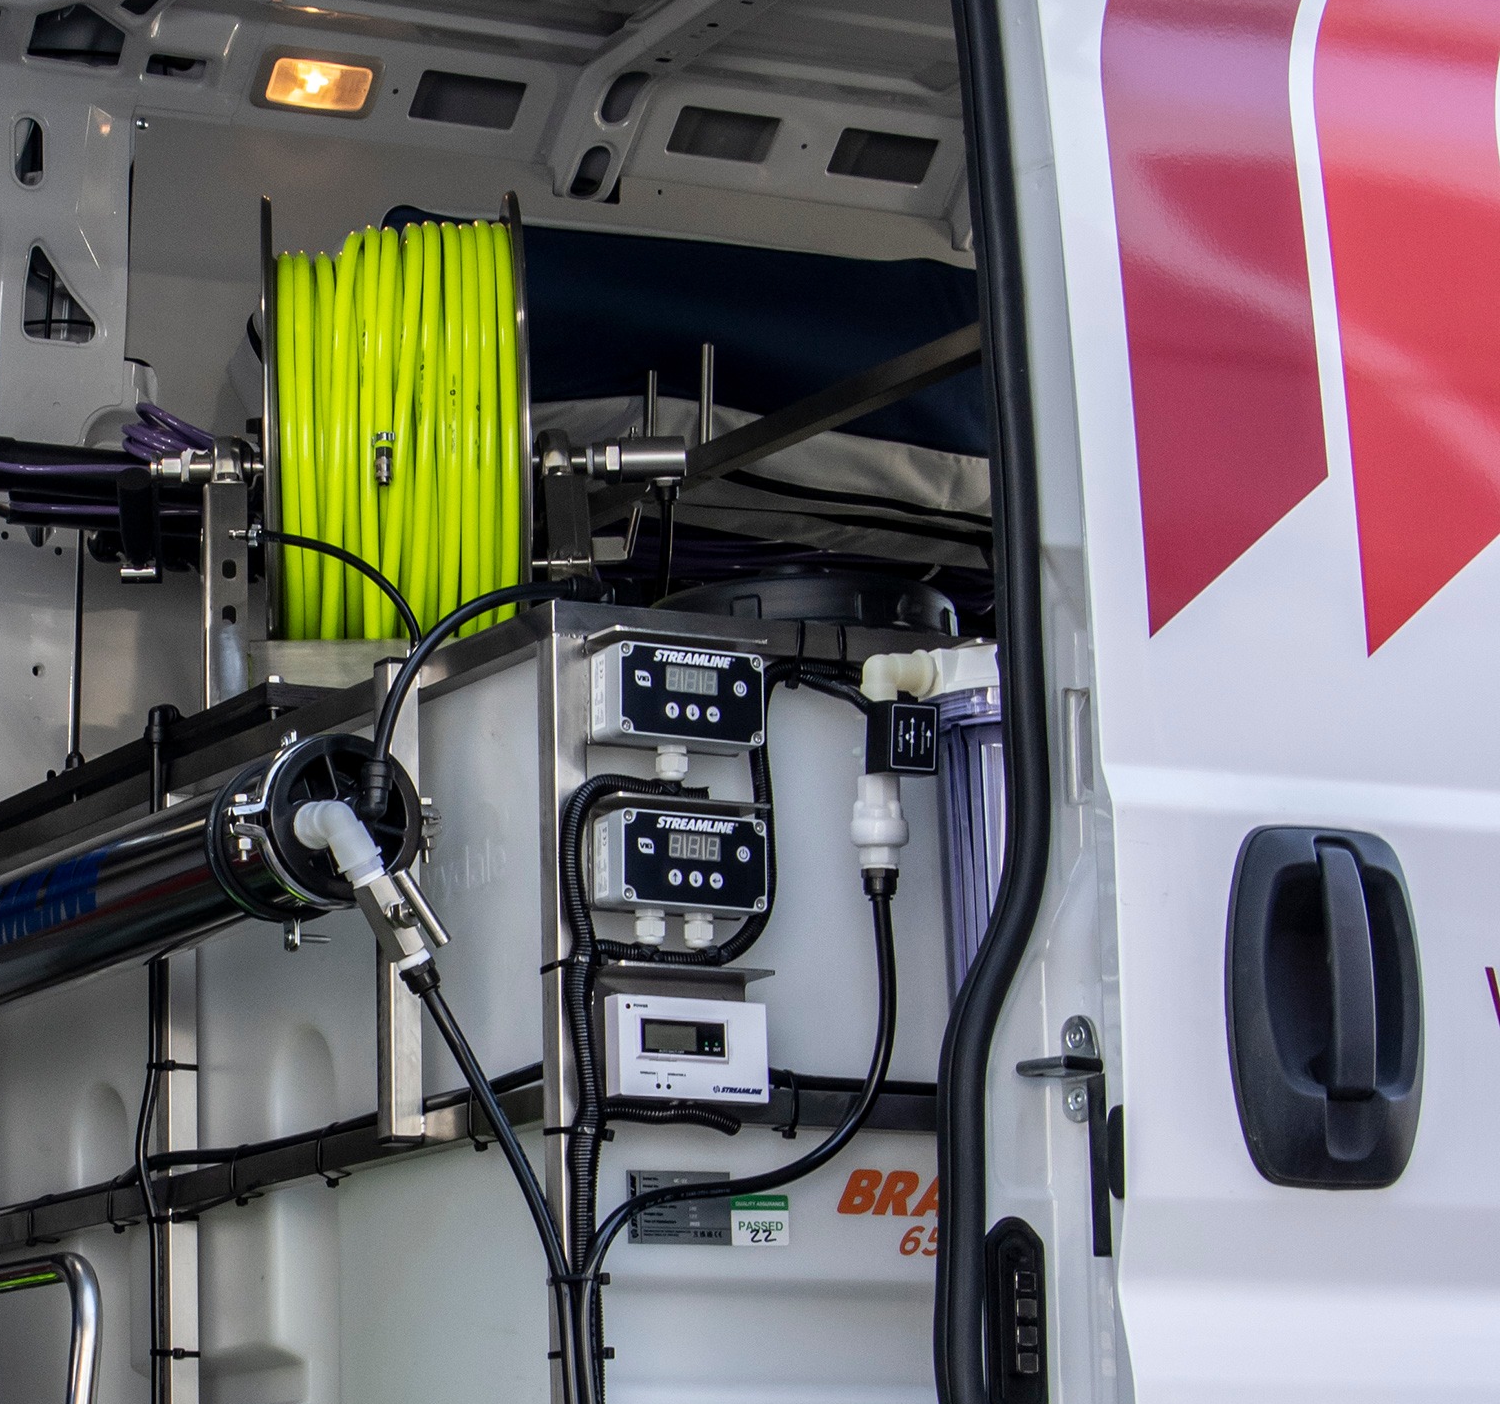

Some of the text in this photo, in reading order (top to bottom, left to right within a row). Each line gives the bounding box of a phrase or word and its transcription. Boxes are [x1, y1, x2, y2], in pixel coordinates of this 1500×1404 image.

[653, 649, 732, 669] STREAMLINE
[656, 815, 735, 834] STREAMLINE
[721, 1086, 763, 1096] STREAMLINE
[837, 1168, 939, 1217] BRA
[738, 1221, 784, 1232] PASSED
[750, 1229, 777, 1243] 22
